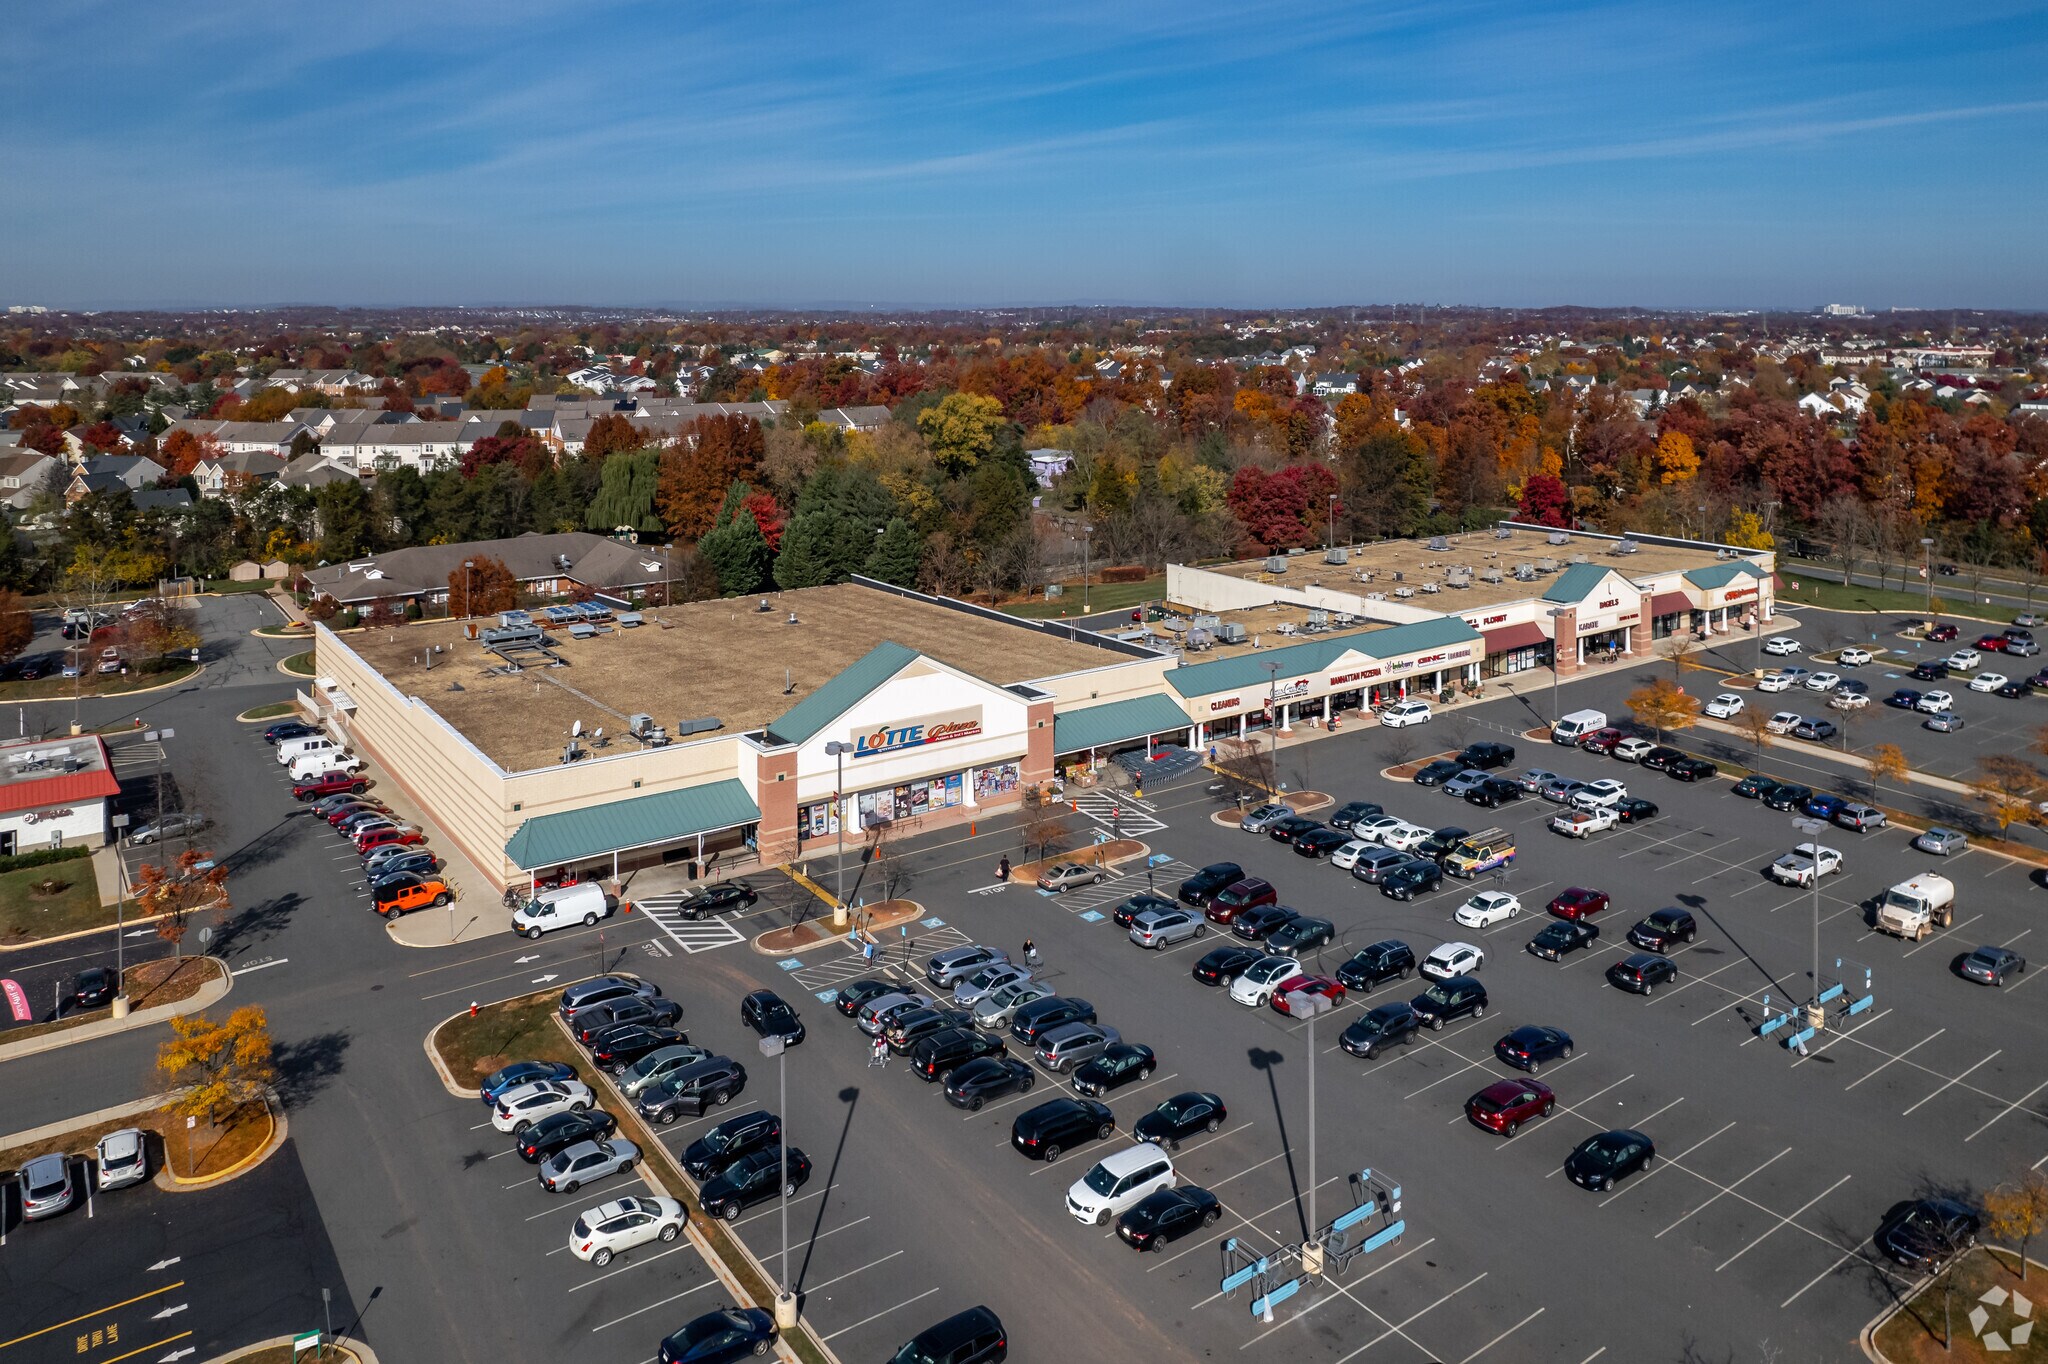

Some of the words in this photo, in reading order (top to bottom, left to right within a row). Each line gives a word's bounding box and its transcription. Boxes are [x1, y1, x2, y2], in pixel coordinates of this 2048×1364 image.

[1599, 599, 1620, 609] BAGELS
[1483, 614, 1508, 625] FLORIST
[1417, 653, 1446, 665] GNC
[1330, 672, 1360, 686] MANHATTAN
[1360, 668, 1382, 680] PIZZERIA
[1210, 697, 1240, 711] CLEANERS
[856, 725, 925, 752] LOTTE
[927, 720, 978, 738] Plaza
[979, 886, 1006, 896] STOP
[641, 943, 662, 958] STOP
[242, 955, 273, 968] STOP
[106, 1322, 118, 1345] LANE
[76, 1333, 89, 1354] DRIVE
